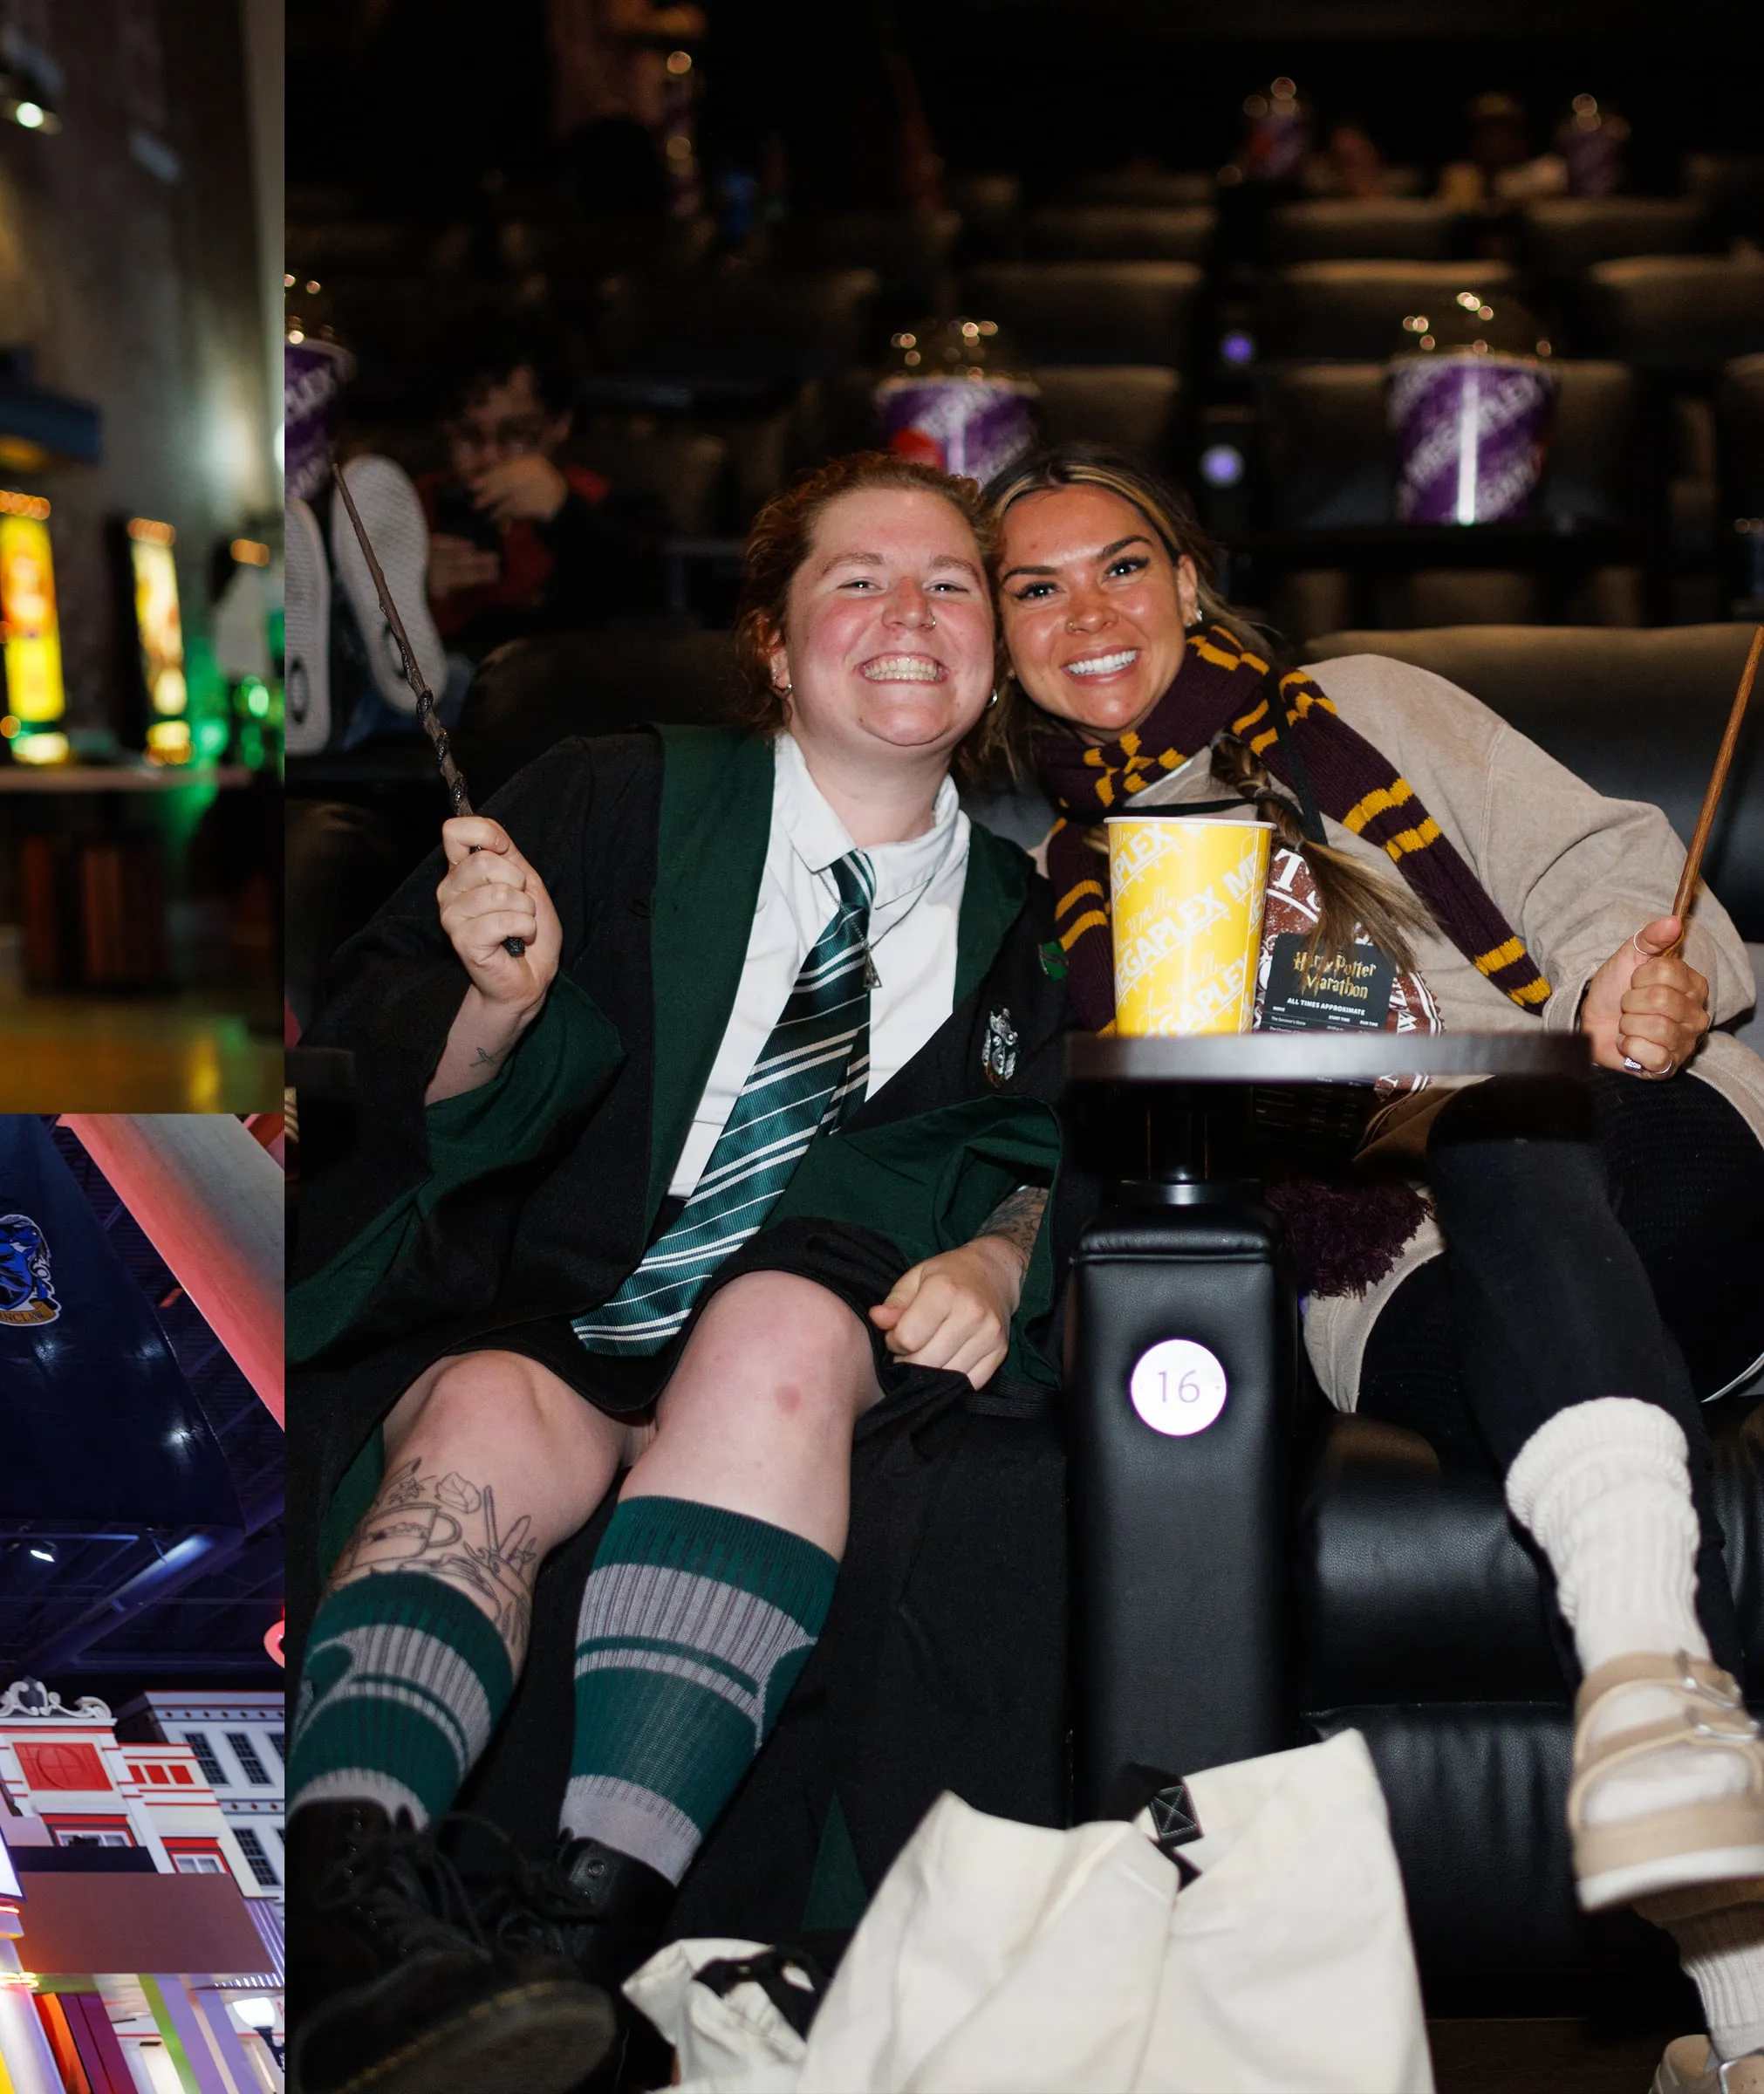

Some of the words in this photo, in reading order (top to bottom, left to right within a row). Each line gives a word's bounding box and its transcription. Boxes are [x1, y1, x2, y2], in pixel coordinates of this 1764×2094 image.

[1334, 955, 1377, 978] Potter
[1301, 973, 1368, 999] Marathon
[1287, 997, 1300, 1006] ALL
[1300, 999, 1321, 1009] TIMES
[1320, 1003, 1366, 1016] APPROXIMATE
[1158, 1370, 1200, 1403] 16
